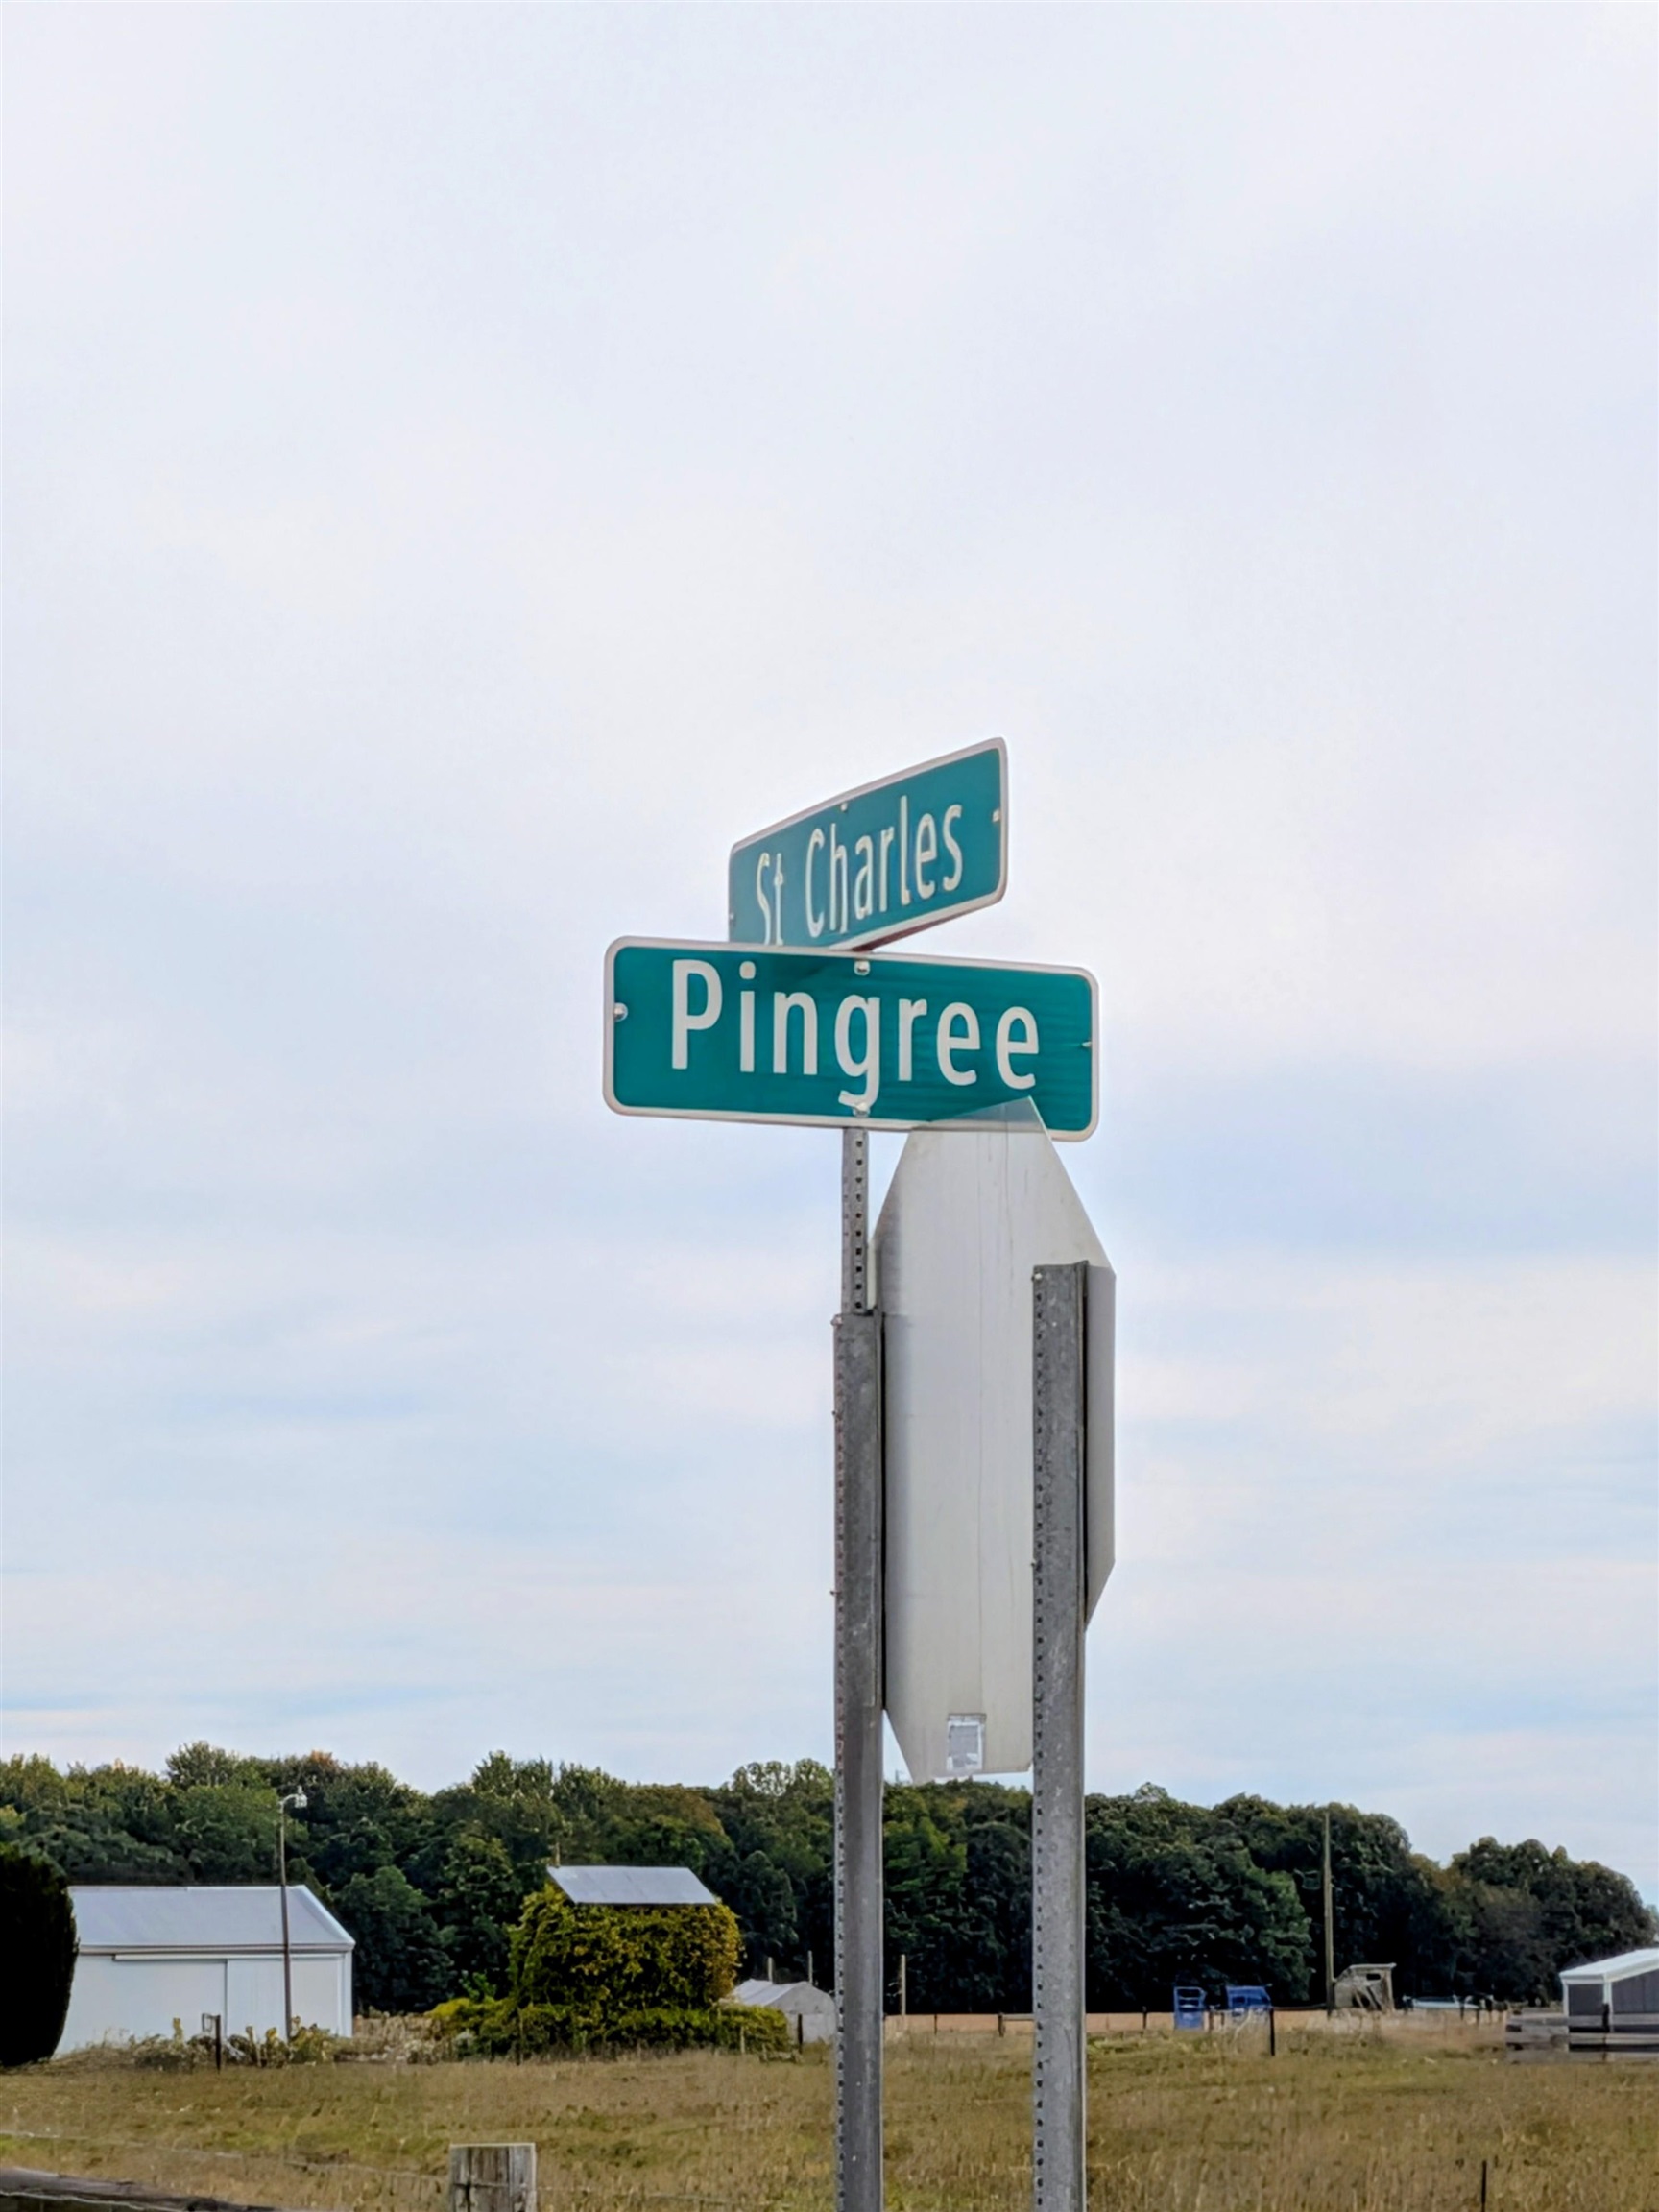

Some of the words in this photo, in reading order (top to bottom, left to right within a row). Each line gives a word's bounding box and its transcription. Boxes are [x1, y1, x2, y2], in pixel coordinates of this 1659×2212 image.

[757, 852, 785, 945] St
[805, 795, 963, 938] Charles
[671, 959, 1040, 1110] Pingree
